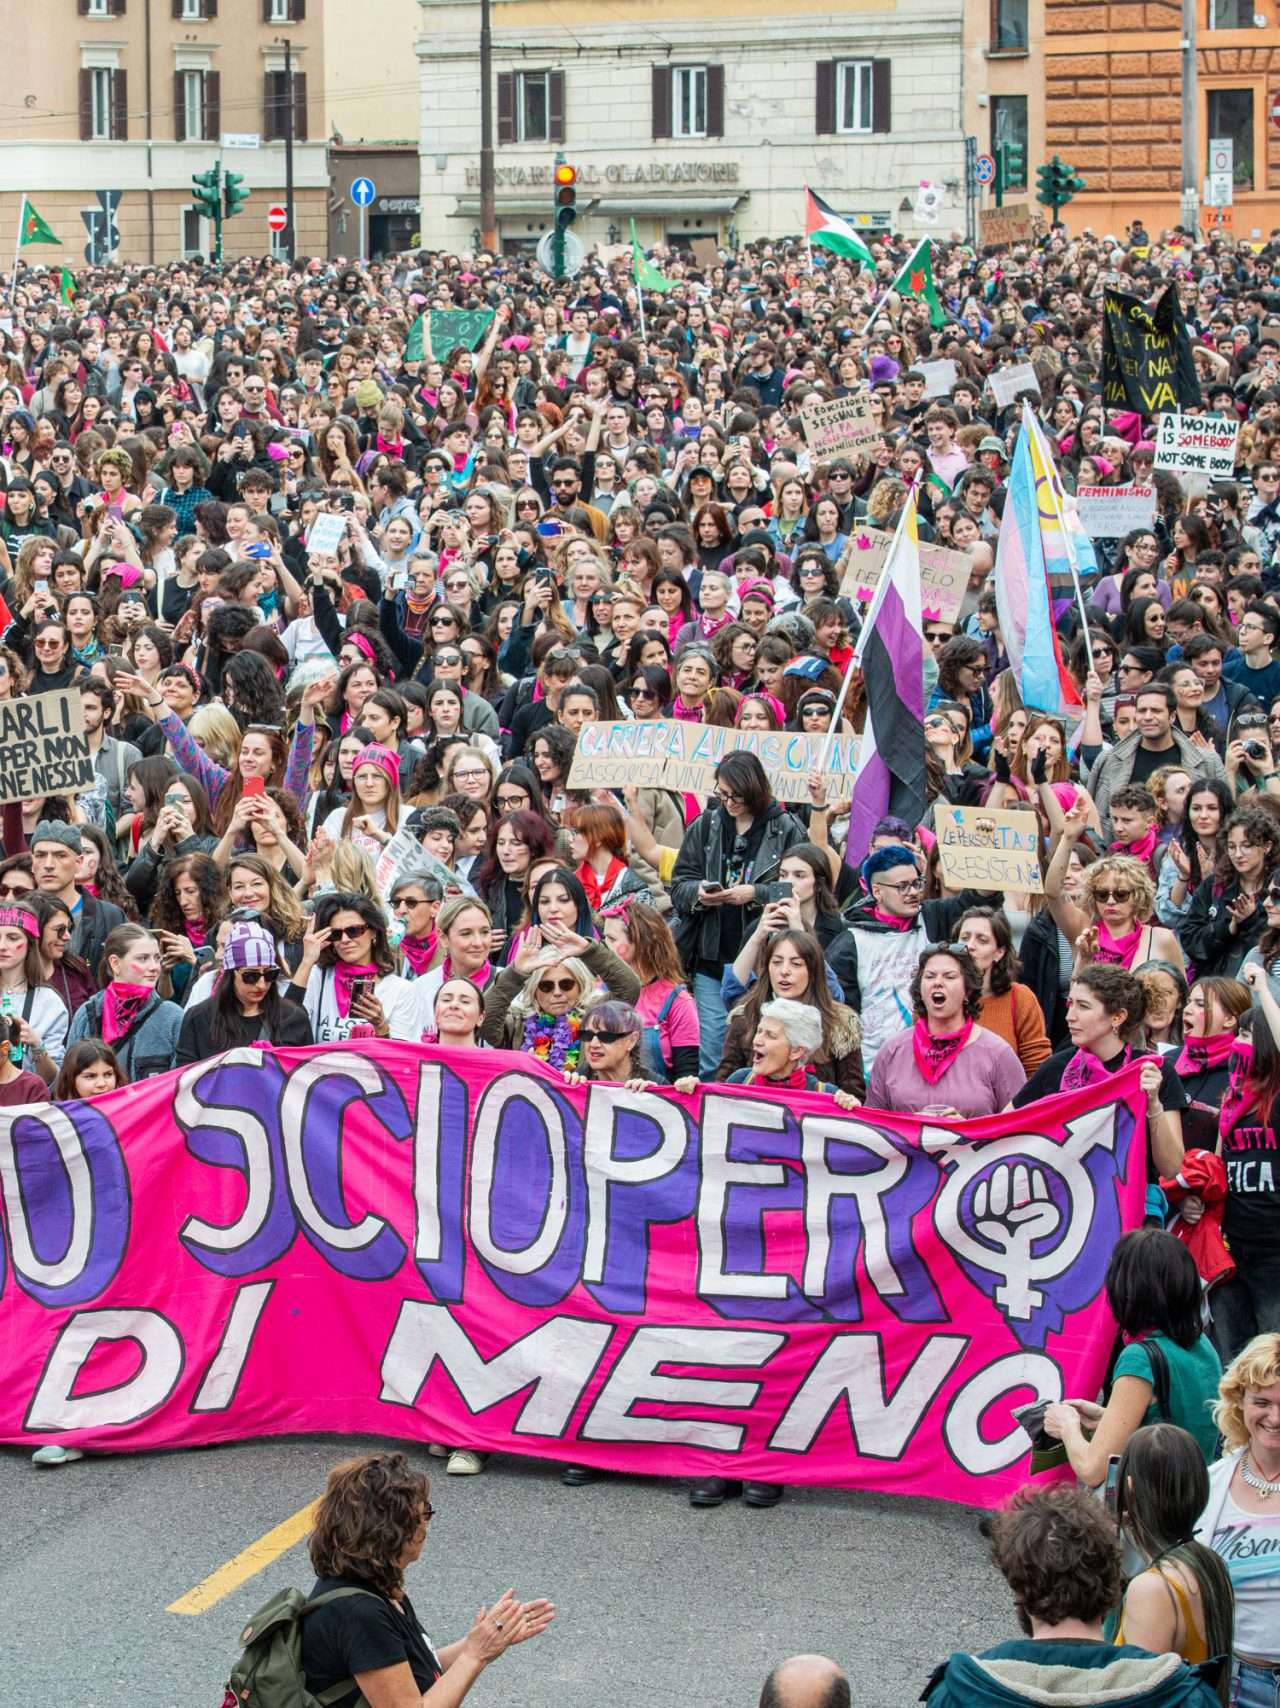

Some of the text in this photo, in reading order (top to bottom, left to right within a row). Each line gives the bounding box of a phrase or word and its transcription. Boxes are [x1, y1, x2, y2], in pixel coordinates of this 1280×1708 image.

[465, 167, 556, 188] HSTARI
[606, 162, 739, 185] GLADIATORE
[1163, 416, 1237, 436] A WOMAN
[1163, 432, 1235, 448] IS SOMEBODY
[1157, 451, 1233, 471] NOT SOME BODY
[1078, 487, 1153, 498] FEMMINISMO
[0, 740, 42, 772] PER
[43, 734, 91, 764] NON
[23, 1279, 276, 1432] DI
[380, 1300, 1065, 1476] MENO
